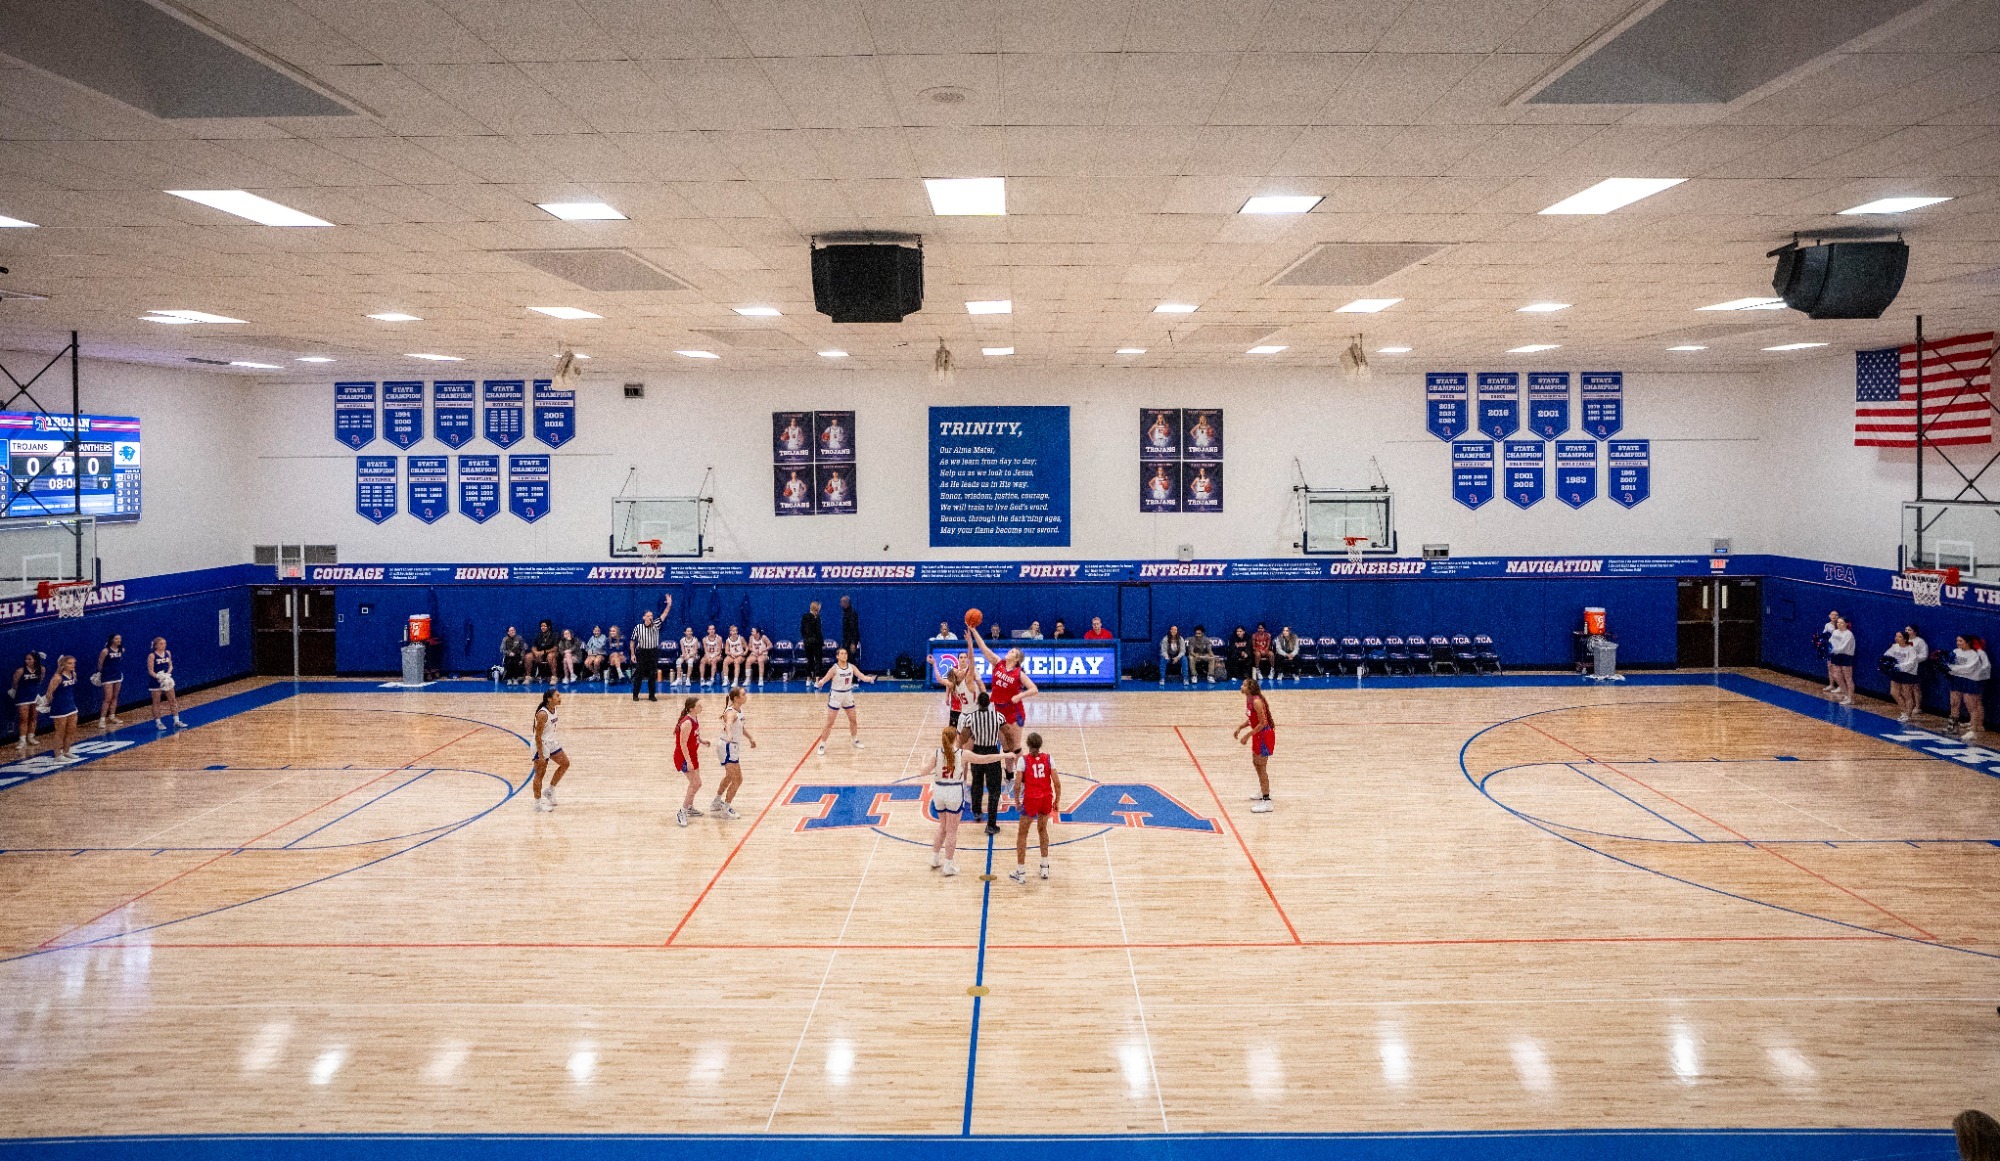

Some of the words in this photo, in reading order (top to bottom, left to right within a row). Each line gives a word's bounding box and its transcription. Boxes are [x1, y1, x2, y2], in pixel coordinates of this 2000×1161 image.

[940, 422, 1023, 437] TRINITY,
[12, 443, 48, 451] TROJANS
[78, 443, 112, 452] ANTHERS
[27, 458, 39, 476] 0
[62, 463, 68, 473] 1
[88, 458, 99, 476] 0
[1000, 458, 1012, 466] day
[49, 478, 76, 489] 08:0
[102, 481, 108, 489] 0
[587, 567, 666, 579] ATTITUDE
[749, 566, 816, 578] MENTAL
[821, 565, 916, 578] TOUGHNESS
[1019, 565, 1080, 578] PURITY
[1140, 564, 1227, 576] INTEGRITY
[1330, 562, 1426, 575] OWNERSHIP
[1506, 560, 1603, 573] NAVIGATION
[313, 568, 385, 580] COURAGE
[455, 567, 509, 580] HONOR
[1824, 564, 1856, 586] TCA
[1891, 575, 1940, 594] HOME
[1945, 586, 1968, 600] OF
[1974, 588, 2000, 606] TH
[0, 601, 26, 618] HE
[32, 585, 125, 613] TROJANS
[1476, 636, 1492, 644] TCA
[995, 670, 1014, 683] PARISH
[1032, 764, 1045, 778] 12
